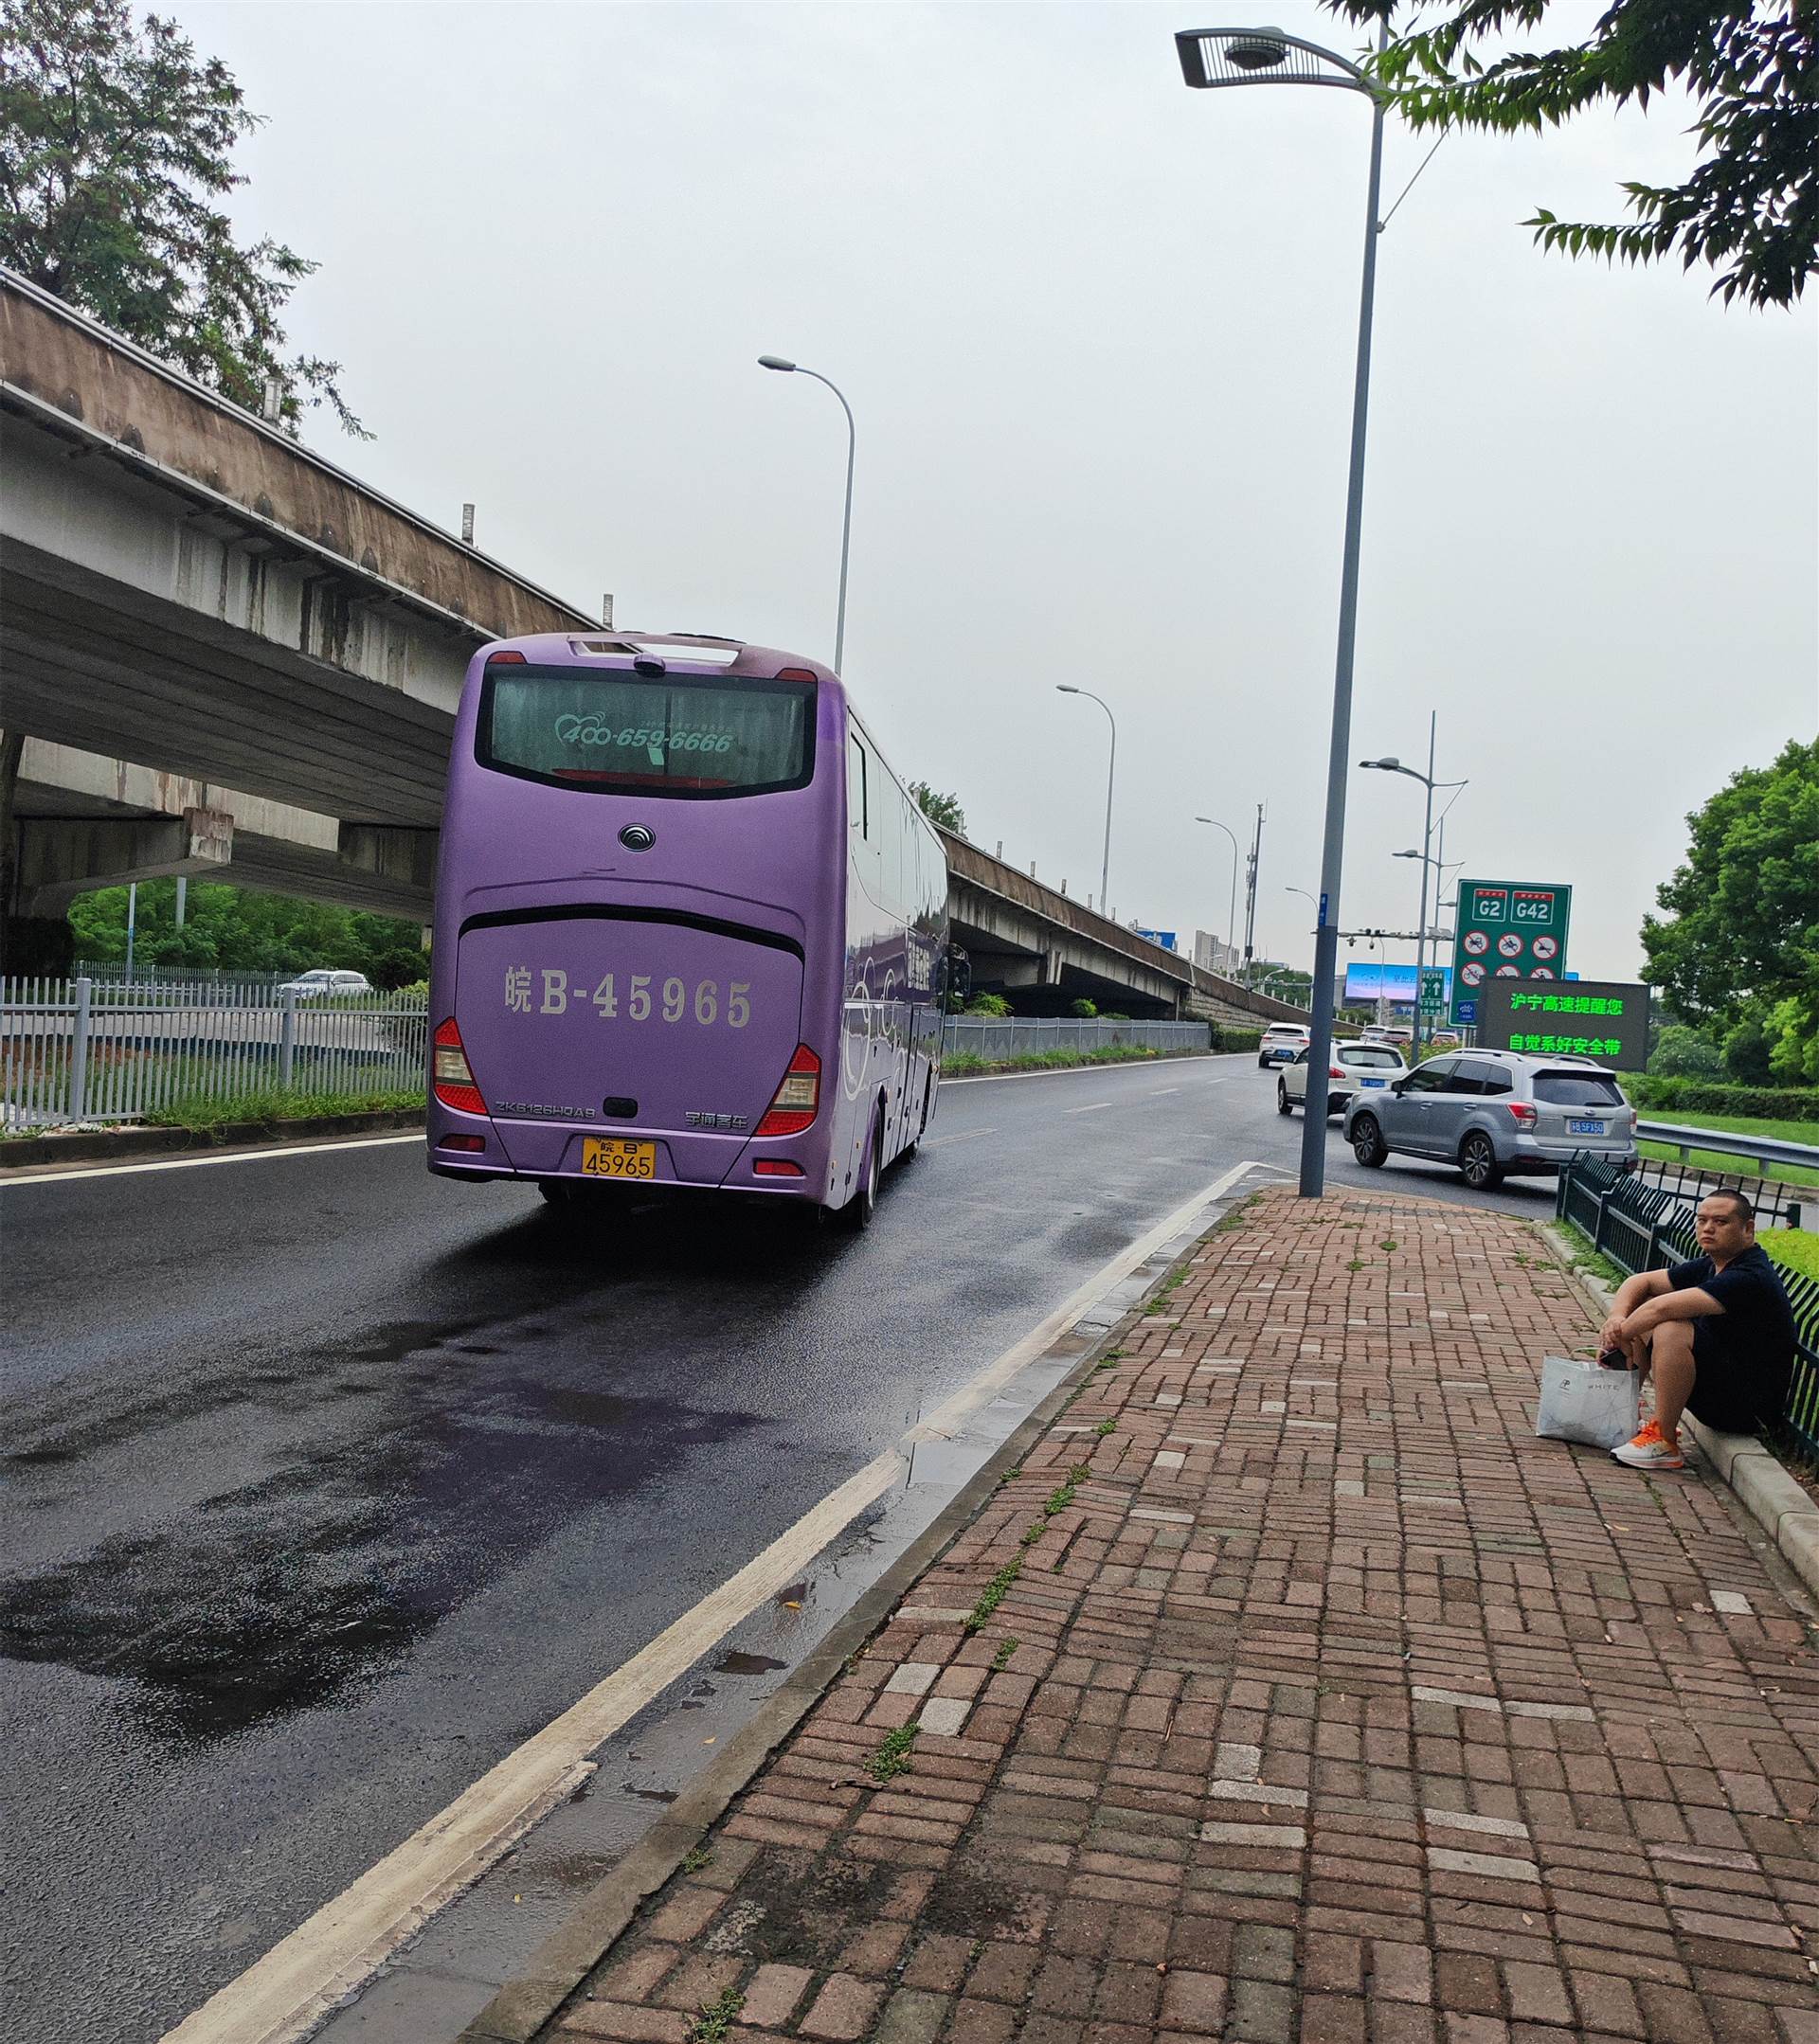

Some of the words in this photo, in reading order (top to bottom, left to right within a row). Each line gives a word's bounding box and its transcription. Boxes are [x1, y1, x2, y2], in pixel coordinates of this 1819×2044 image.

[563, 726, 733, 753] 400-659-6666
[1479, 900, 1501, 917] G2
[1516, 903, 1549, 920] G42
[1510, 993, 1623, 1016] 沪宁高速提醒您
[1509, 1033, 1622, 1055] 自觉系好安全带
[685, 1111, 748, 1130] 宇通客车
[585, 1153, 650, 1176] 45965
